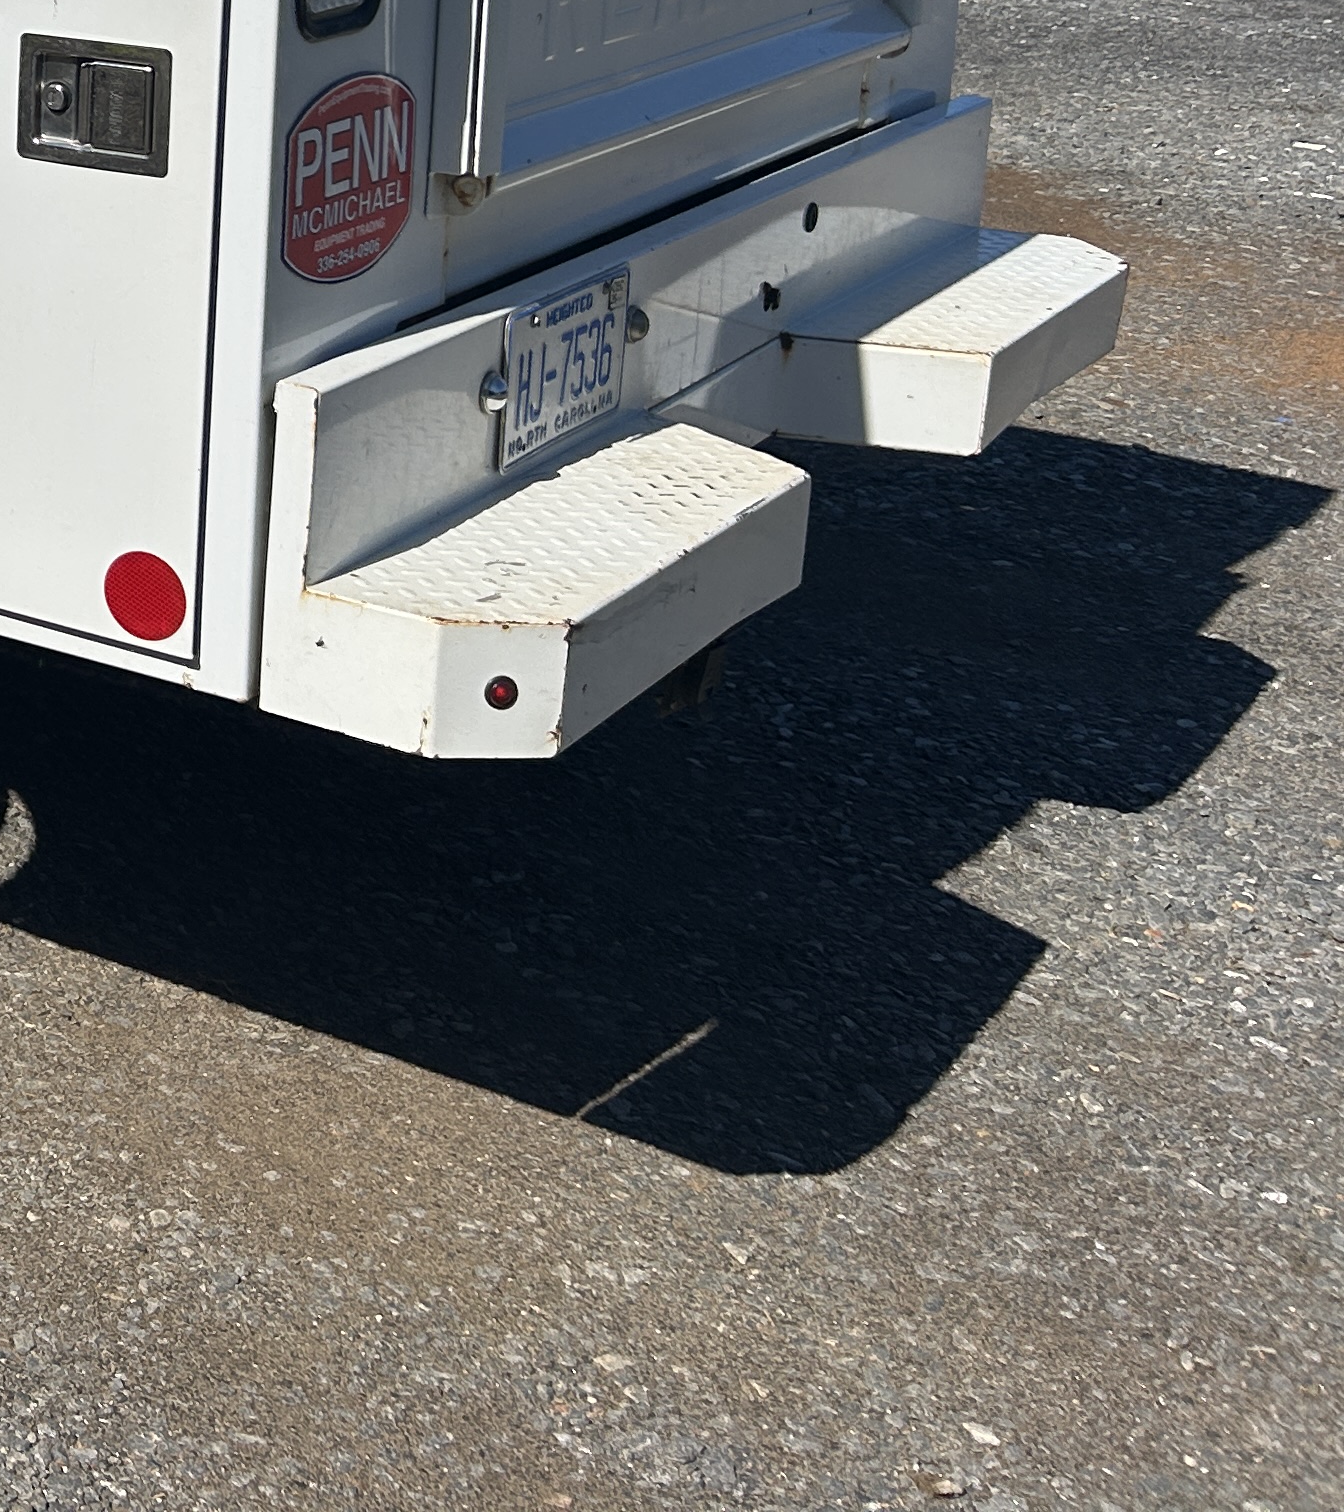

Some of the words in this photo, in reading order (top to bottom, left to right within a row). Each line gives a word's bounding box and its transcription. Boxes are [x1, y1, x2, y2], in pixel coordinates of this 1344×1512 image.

[295, 100, 408, 207] PENN
[292, 179, 405, 240] MCMICHAEL
[314, 227, 355, 252] EQUIPMENT
[356, 216, 385, 236] TRADING
[317, 237, 380, 273] 336-254-0906
[515, 313, 615, 430] HJ-7536
